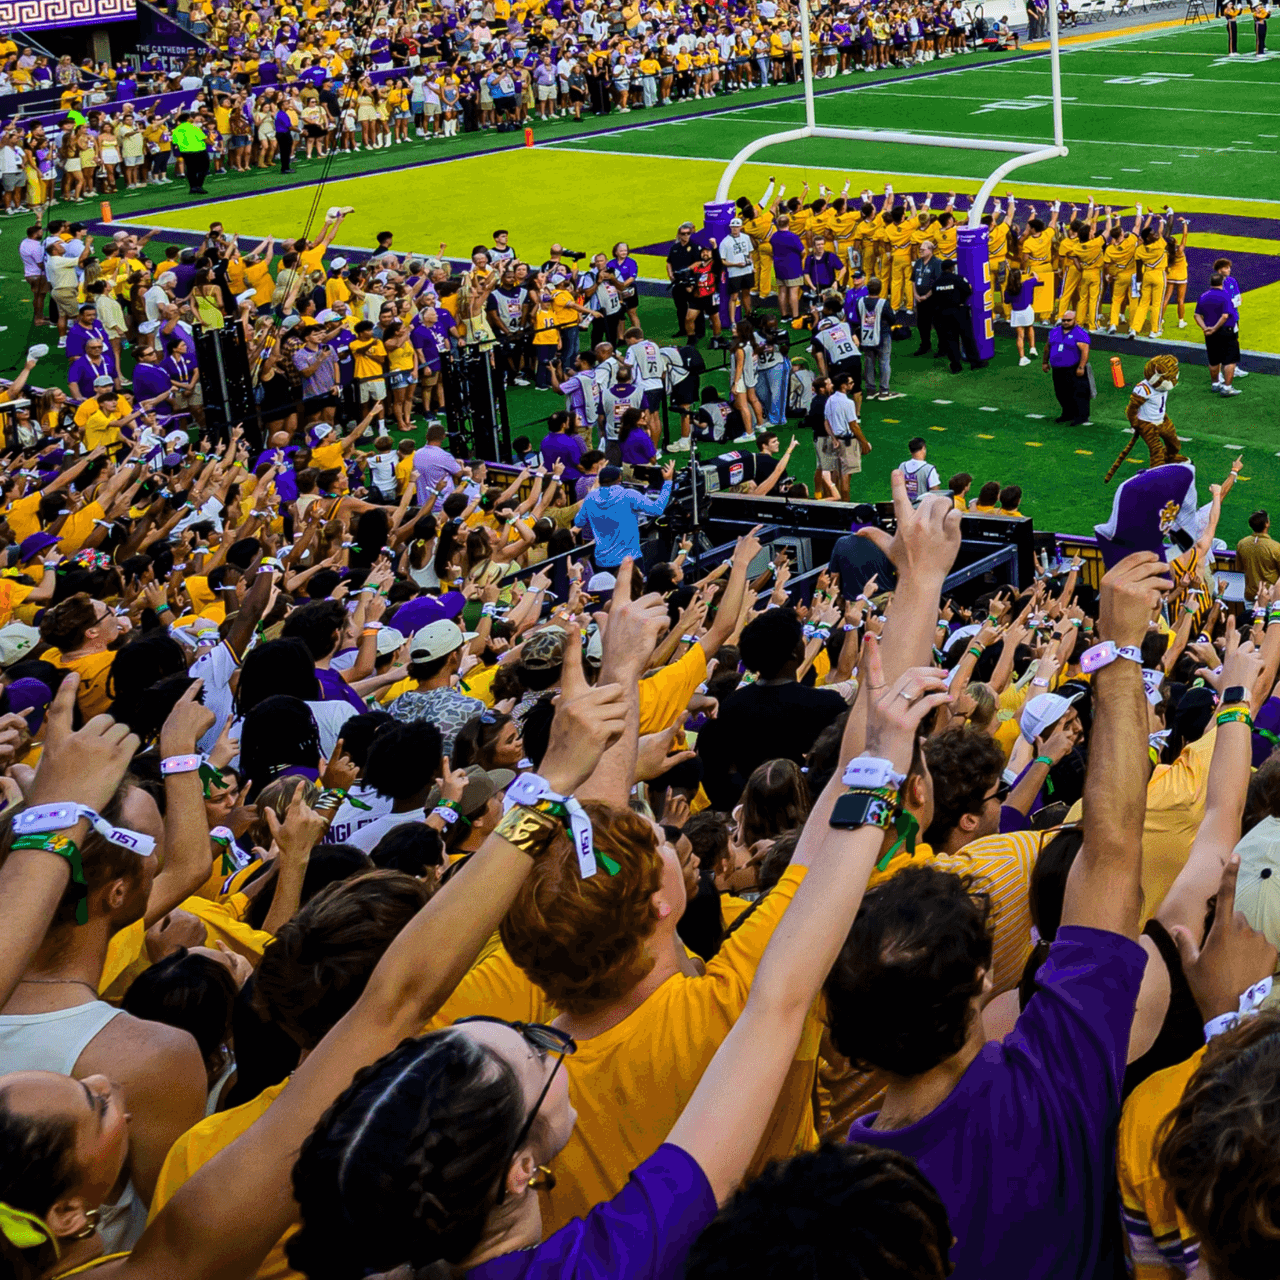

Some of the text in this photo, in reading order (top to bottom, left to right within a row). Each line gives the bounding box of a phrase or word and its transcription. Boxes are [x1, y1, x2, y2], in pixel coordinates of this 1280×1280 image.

[136, 44, 150, 53] THE
[152, 45, 194, 54] CATHEDR
[862, 329, 875, 342] 74
[837, 343, 853, 355] 18
[760, 353, 774, 364] 92
[1159, 396, 1165, 414] 1
[390, 462, 396, 477] 1
[110, 830, 138, 848] LSU
[580, 828, 590, 856] LSU
